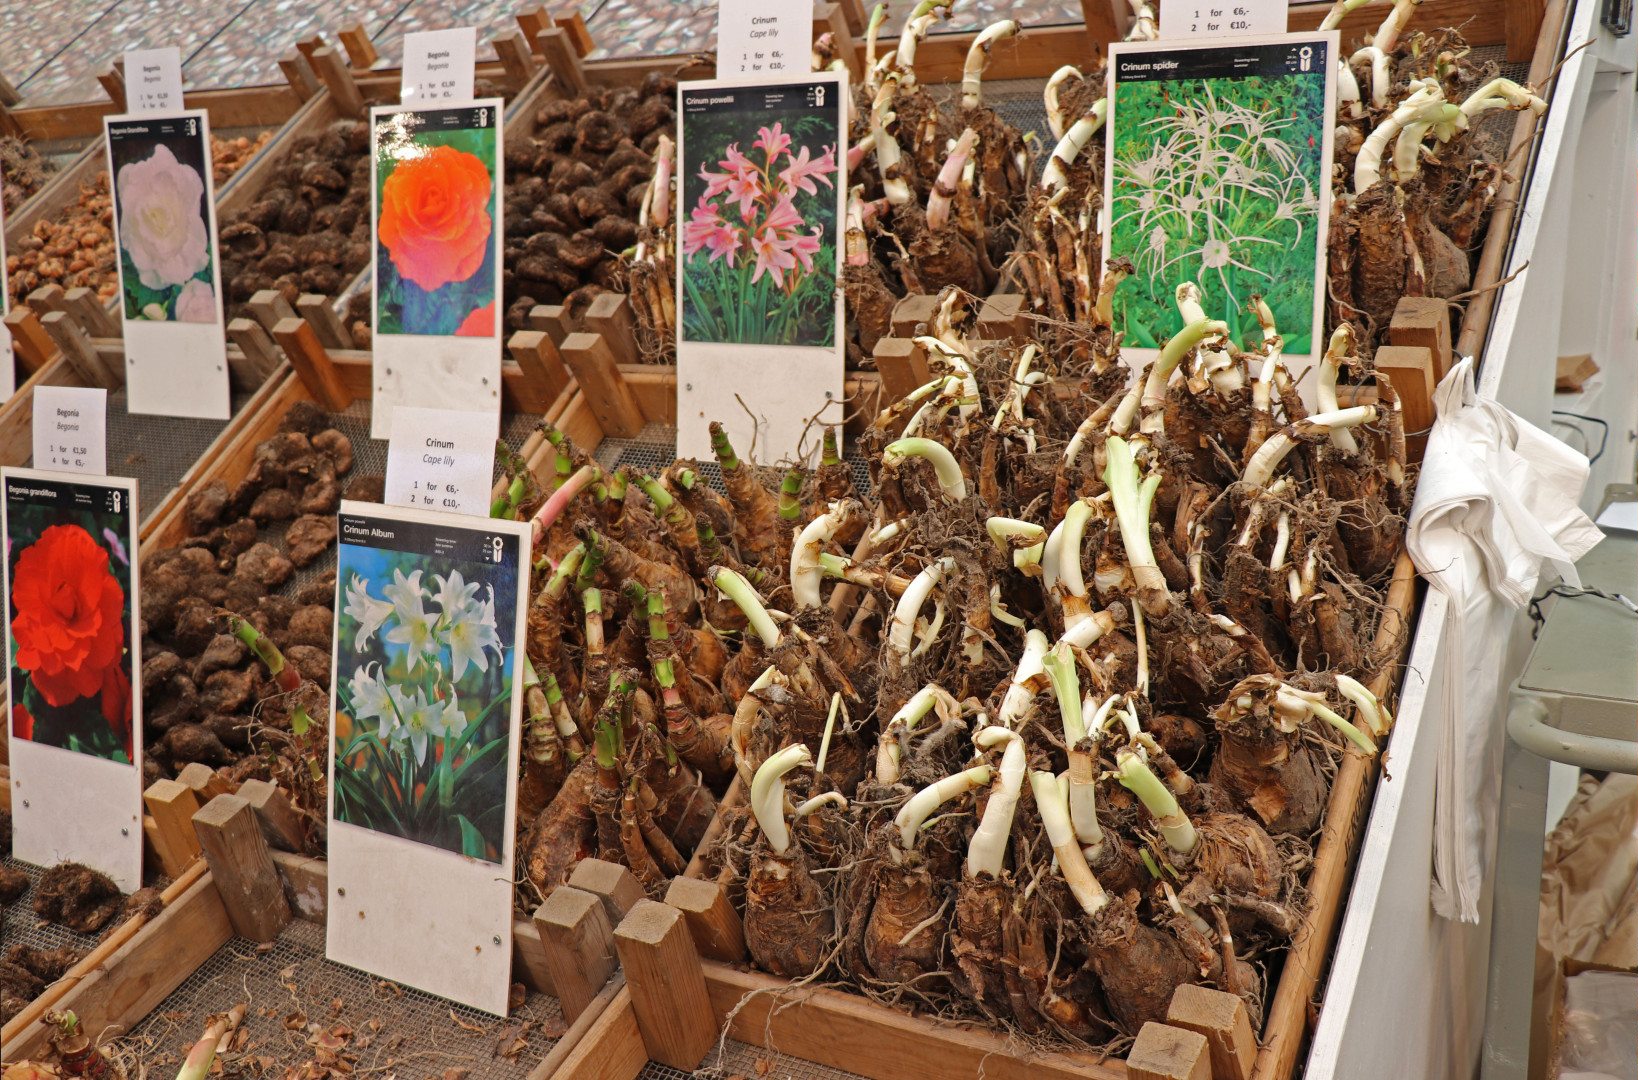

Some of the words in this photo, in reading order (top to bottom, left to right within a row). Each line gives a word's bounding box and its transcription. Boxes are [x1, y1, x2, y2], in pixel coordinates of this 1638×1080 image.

[1210, 9, 1222, 17] for
[1234, 8, 1250, 16] €6,-
[752, 16, 777, 24] Crinum
[1208, 22, 1220, 30] for
[1230, 22, 1251, 30] €10,-
[750, 30, 766, 38] Cape
[428, 51, 450, 60] Begonia
[427, 62, 449, 70] Begonia
[1121, 63, 1150, 72] Crinum
[1152, 62, 1178, 72] spider
[686, 97, 708, 105] Crinum
[57, 408, 79, 417] Begonia
[57, 422, 79, 431] Begonia
[426, 438, 454, 449] Crinum
[423, 454, 442, 464] Cape
[444, 456, 455, 466] lily
[9, 486, 28, 494] Begonia
[30, 487, 56, 497] grandiflora
[427, 482, 437, 490] for
[446, 484, 459, 494] €6,-
[443, 498, 460, 508] €10,-
[344, 525, 369, 535] Crinum
[371, 528, 394, 538] Album
[1344, 767, 1369, 868] JEROEN
